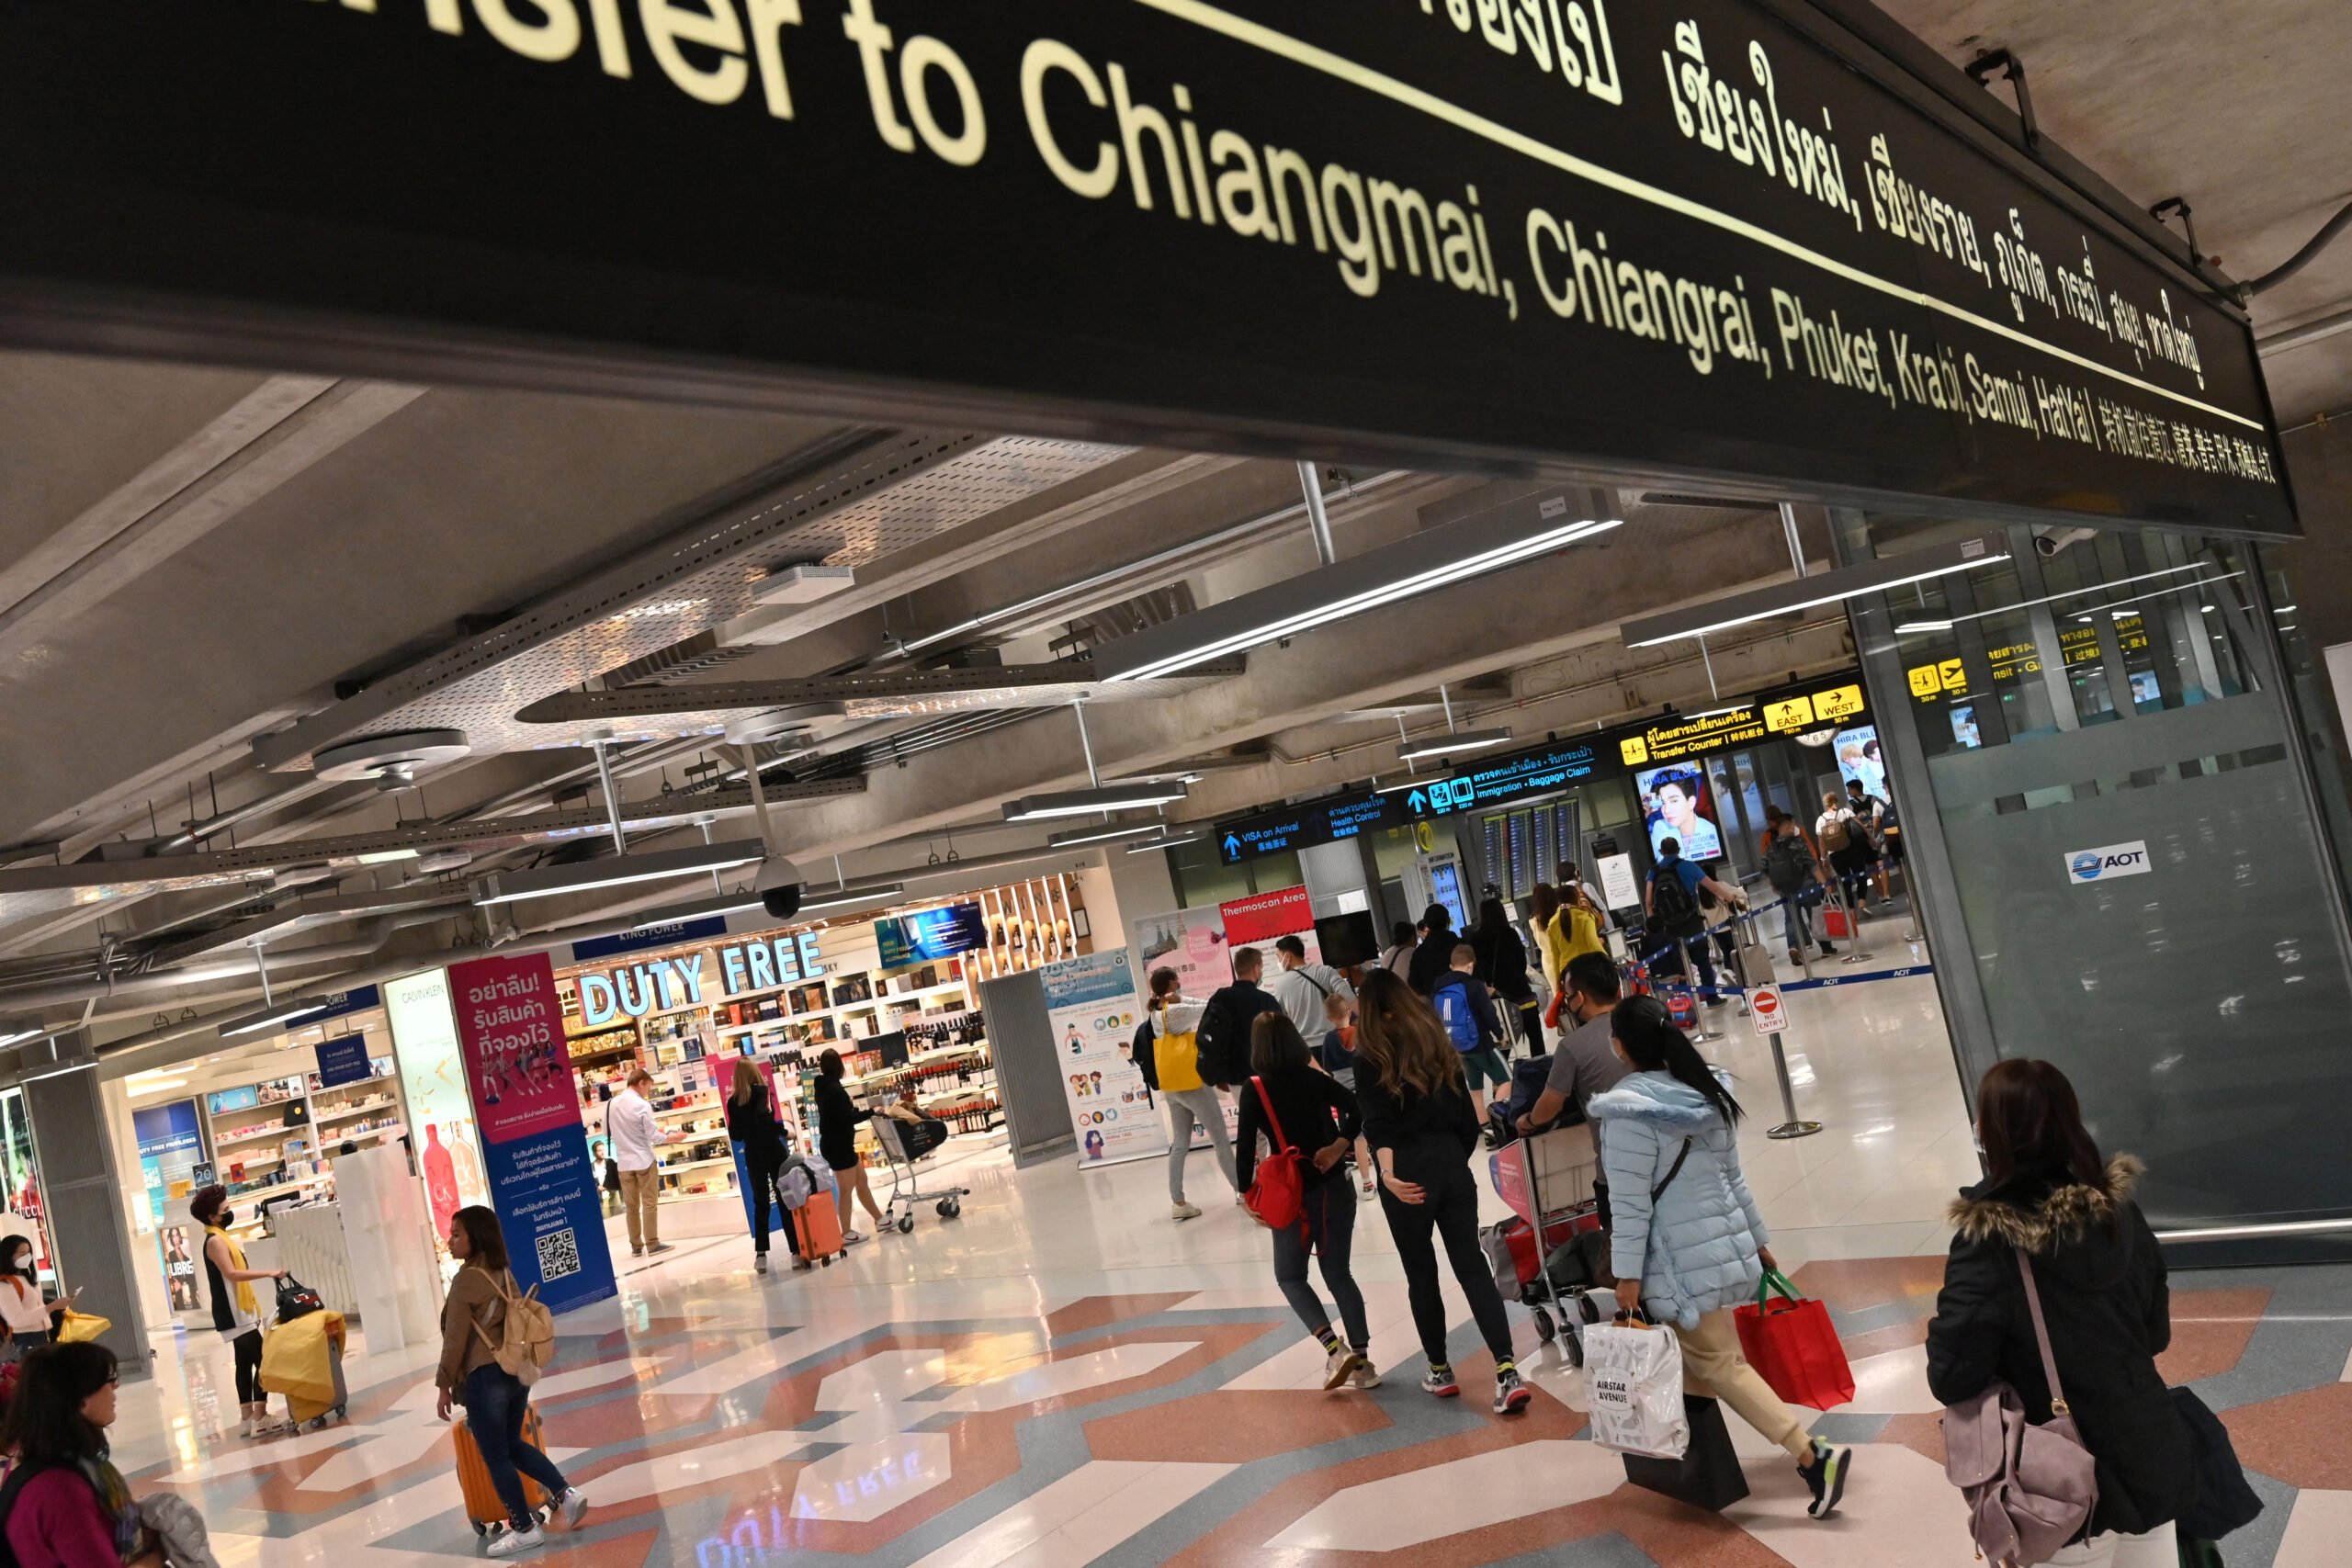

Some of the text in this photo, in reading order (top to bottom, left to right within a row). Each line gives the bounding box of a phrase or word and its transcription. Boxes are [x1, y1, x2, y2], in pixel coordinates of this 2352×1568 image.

[1863, 132, 1992, 288] เชียงราย,
[842, 0, 987, 166] to
[1020, 39, 1518, 321] Chiangmai,
[1526, 208, 1773, 380] Chiangrai,
[1770, 287, 1896, 411] Phuket,
[1889, 329, 1973, 426] Krabi,
[1964, 352, 2041, 441] Samui,
[1824, 701, 1855, 716] WEST
[1776, 714, 1804, 728] EAST
[1651, 736, 1723, 761] Transfer Counter
[1837, 734, 1858, 744] HIRA
[1476, 765, 1591, 799] Immigration Baggage Claim
[1643, 774, 1669, 787] HIRA
[1330, 809, 1381, 829] Health Control
[1241, 820, 1300, 843] VISA on Arrival
[2105, 851, 2143, 868] AOT
[1002, 891, 1062, 915] WINE
[1223, 892, 1306, 918] Thermoscan Area
[580, 931, 825, 1026] DUTY FREE
[1823, 977, 1840, 986] AOT
[1894, 968, 1911, 977] AOT
[402, 984, 445, 1004] CALVIN KLEIN
[469, 972, 540, 1003] อย่าลืม!
[473, 998, 546, 1030] รับสินค้า
[1758, 1019, 1784, 1030] ENTRY
[479, 1021, 550, 1055] ที่จองไว้
[195, 1168, 212, 1183] 20
[170, 1259, 194, 1277] LIBRE
[1596, 1380, 1627, 1393] AIRSTAR
[1599, 1392, 1629, 1404] AVENUE
